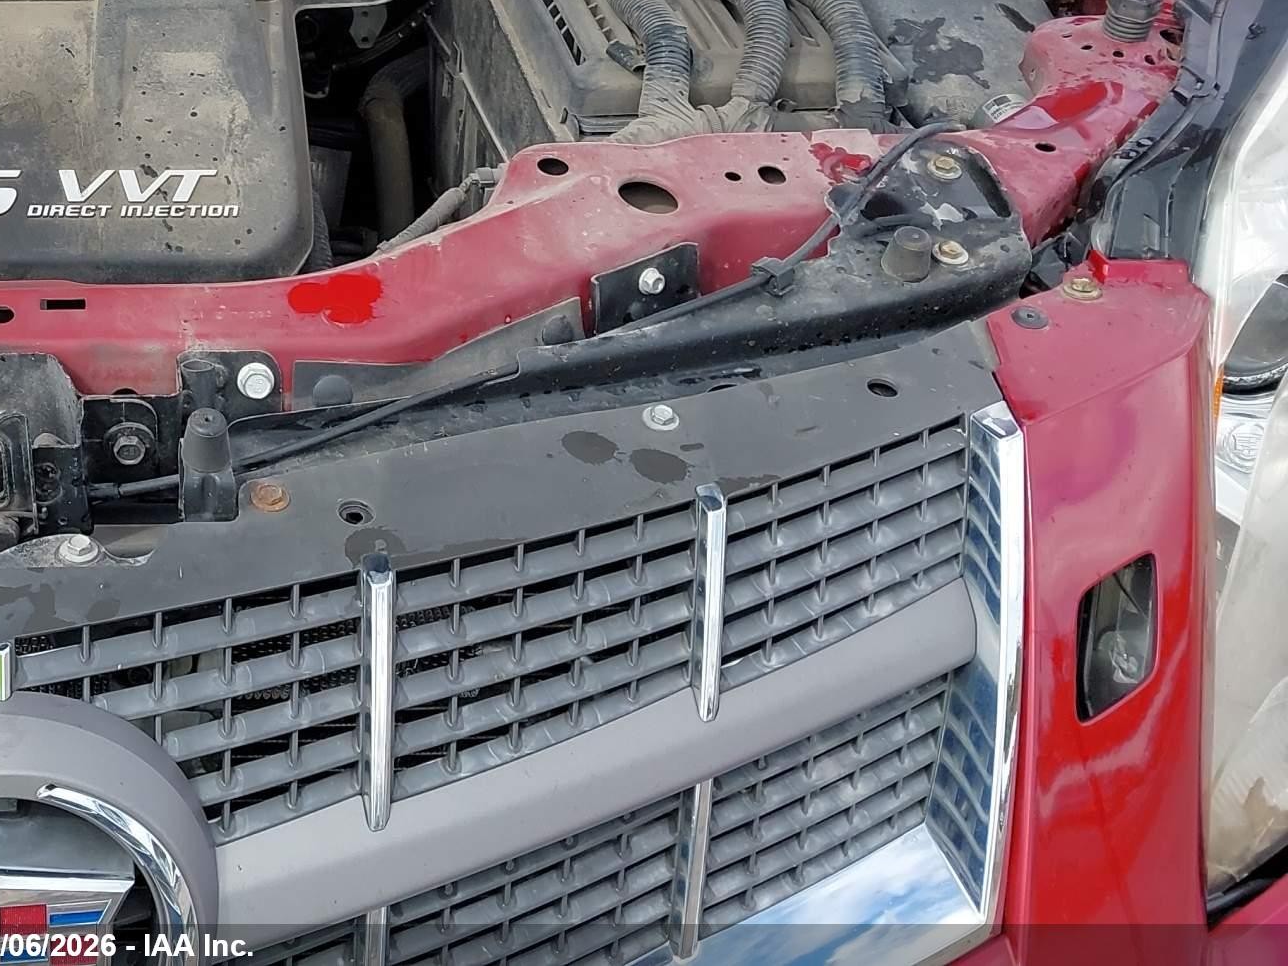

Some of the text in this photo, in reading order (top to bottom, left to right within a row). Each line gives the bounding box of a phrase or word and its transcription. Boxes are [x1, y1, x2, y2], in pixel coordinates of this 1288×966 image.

[58, 169, 218, 203] VVT
[27, 204, 240, 218] DIRECT INJECTION
